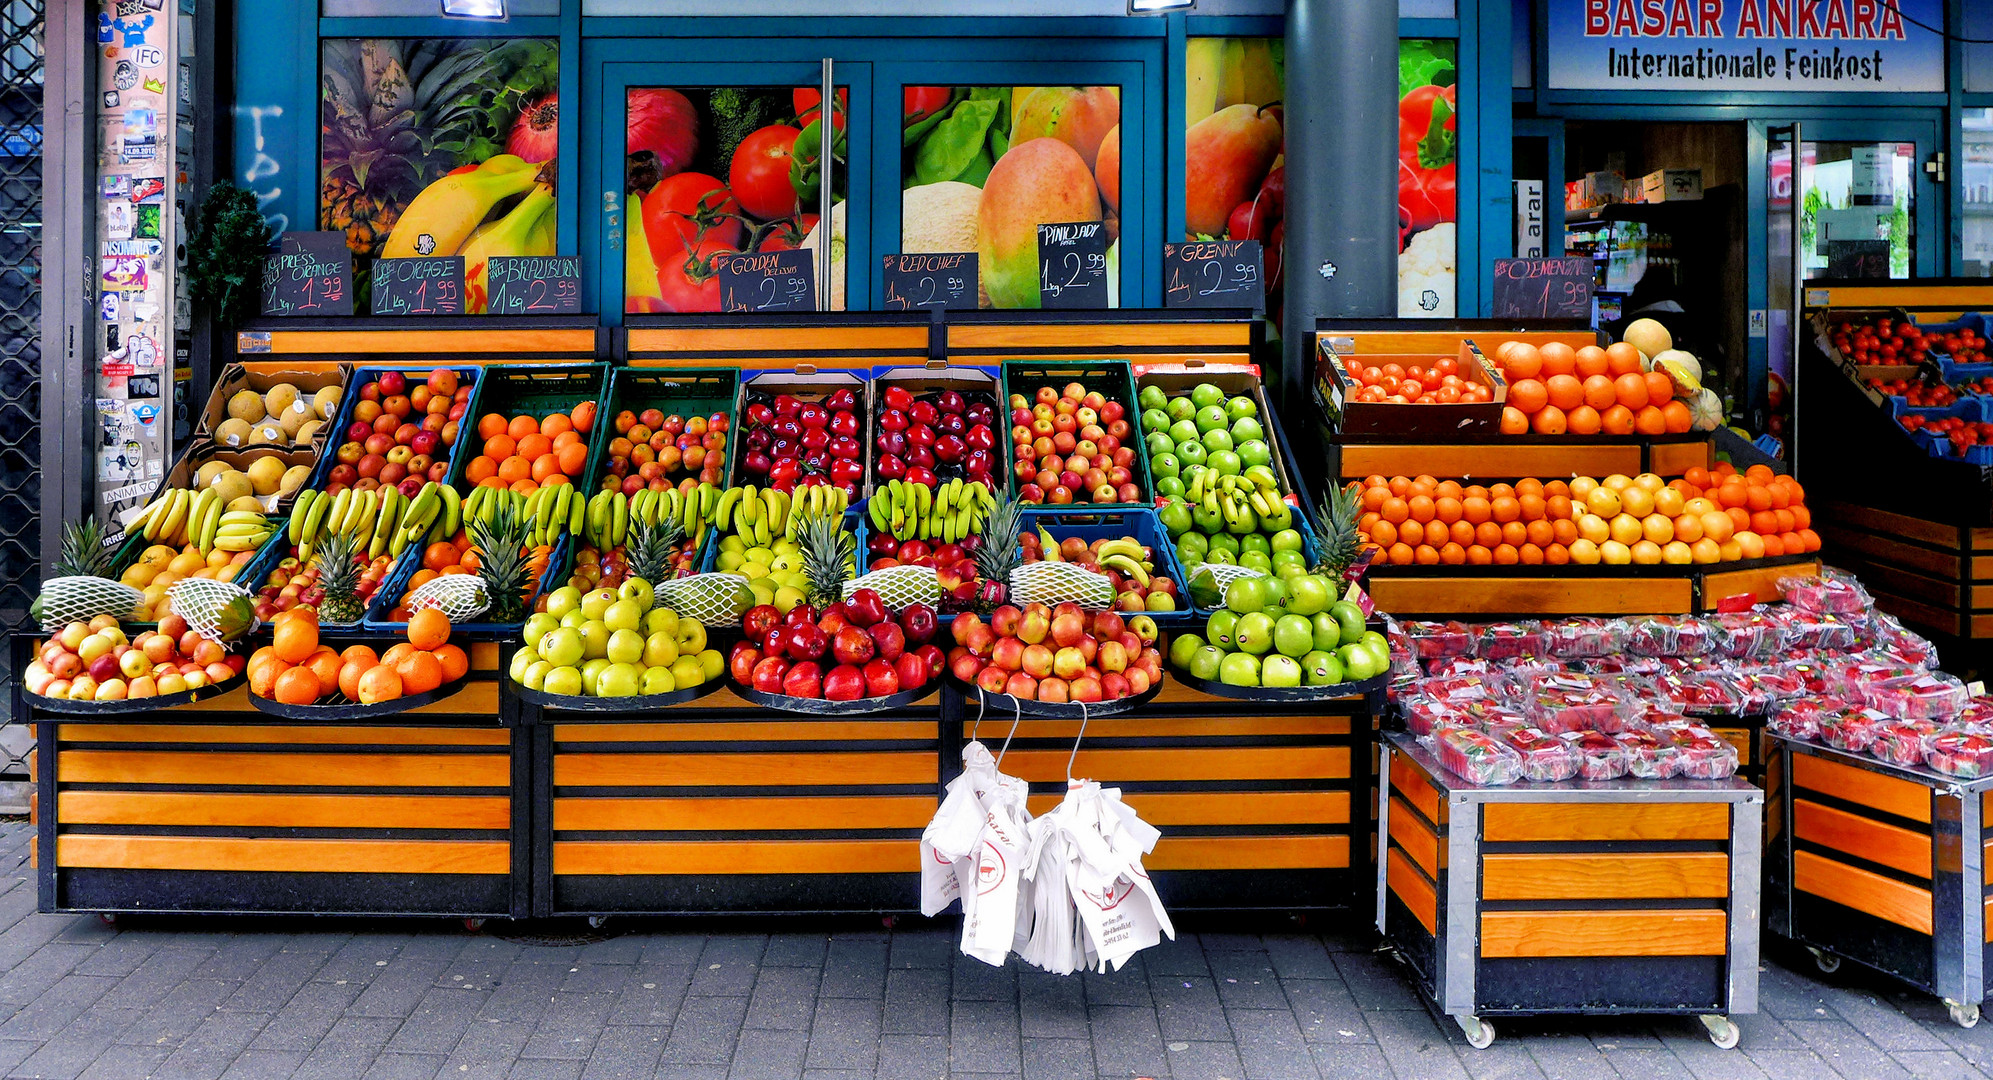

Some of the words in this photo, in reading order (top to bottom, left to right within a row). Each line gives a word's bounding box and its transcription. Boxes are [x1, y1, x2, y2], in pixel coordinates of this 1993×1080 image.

[1584, 0, 1722, 37] BASAR
[1736, 0, 1906, 40] ANKARA
[136, 49, 160, 64] IFC
[1609, 47, 1775, 80] Internationale
[1785, 47, 1883, 81] Feinkost
[1528, 186, 1541, 237] arar
[1045, 226, 1070, 246] PINK
[1067, 224, 1100, 239] LADY
[103, 241, 148, 255] INSOMNIA
[1181, 241, 1244, 261] GRENNY
[281, 253, 315, 270] PRESS
[292, 262, 343, 281] ORANGE
[398, 261, 455, 282] ORAGE
[731, 253, 780, 275] GOLDEN
[899, 255, 927, 272] RED
[927, 254, 965, 272] CHIEF
